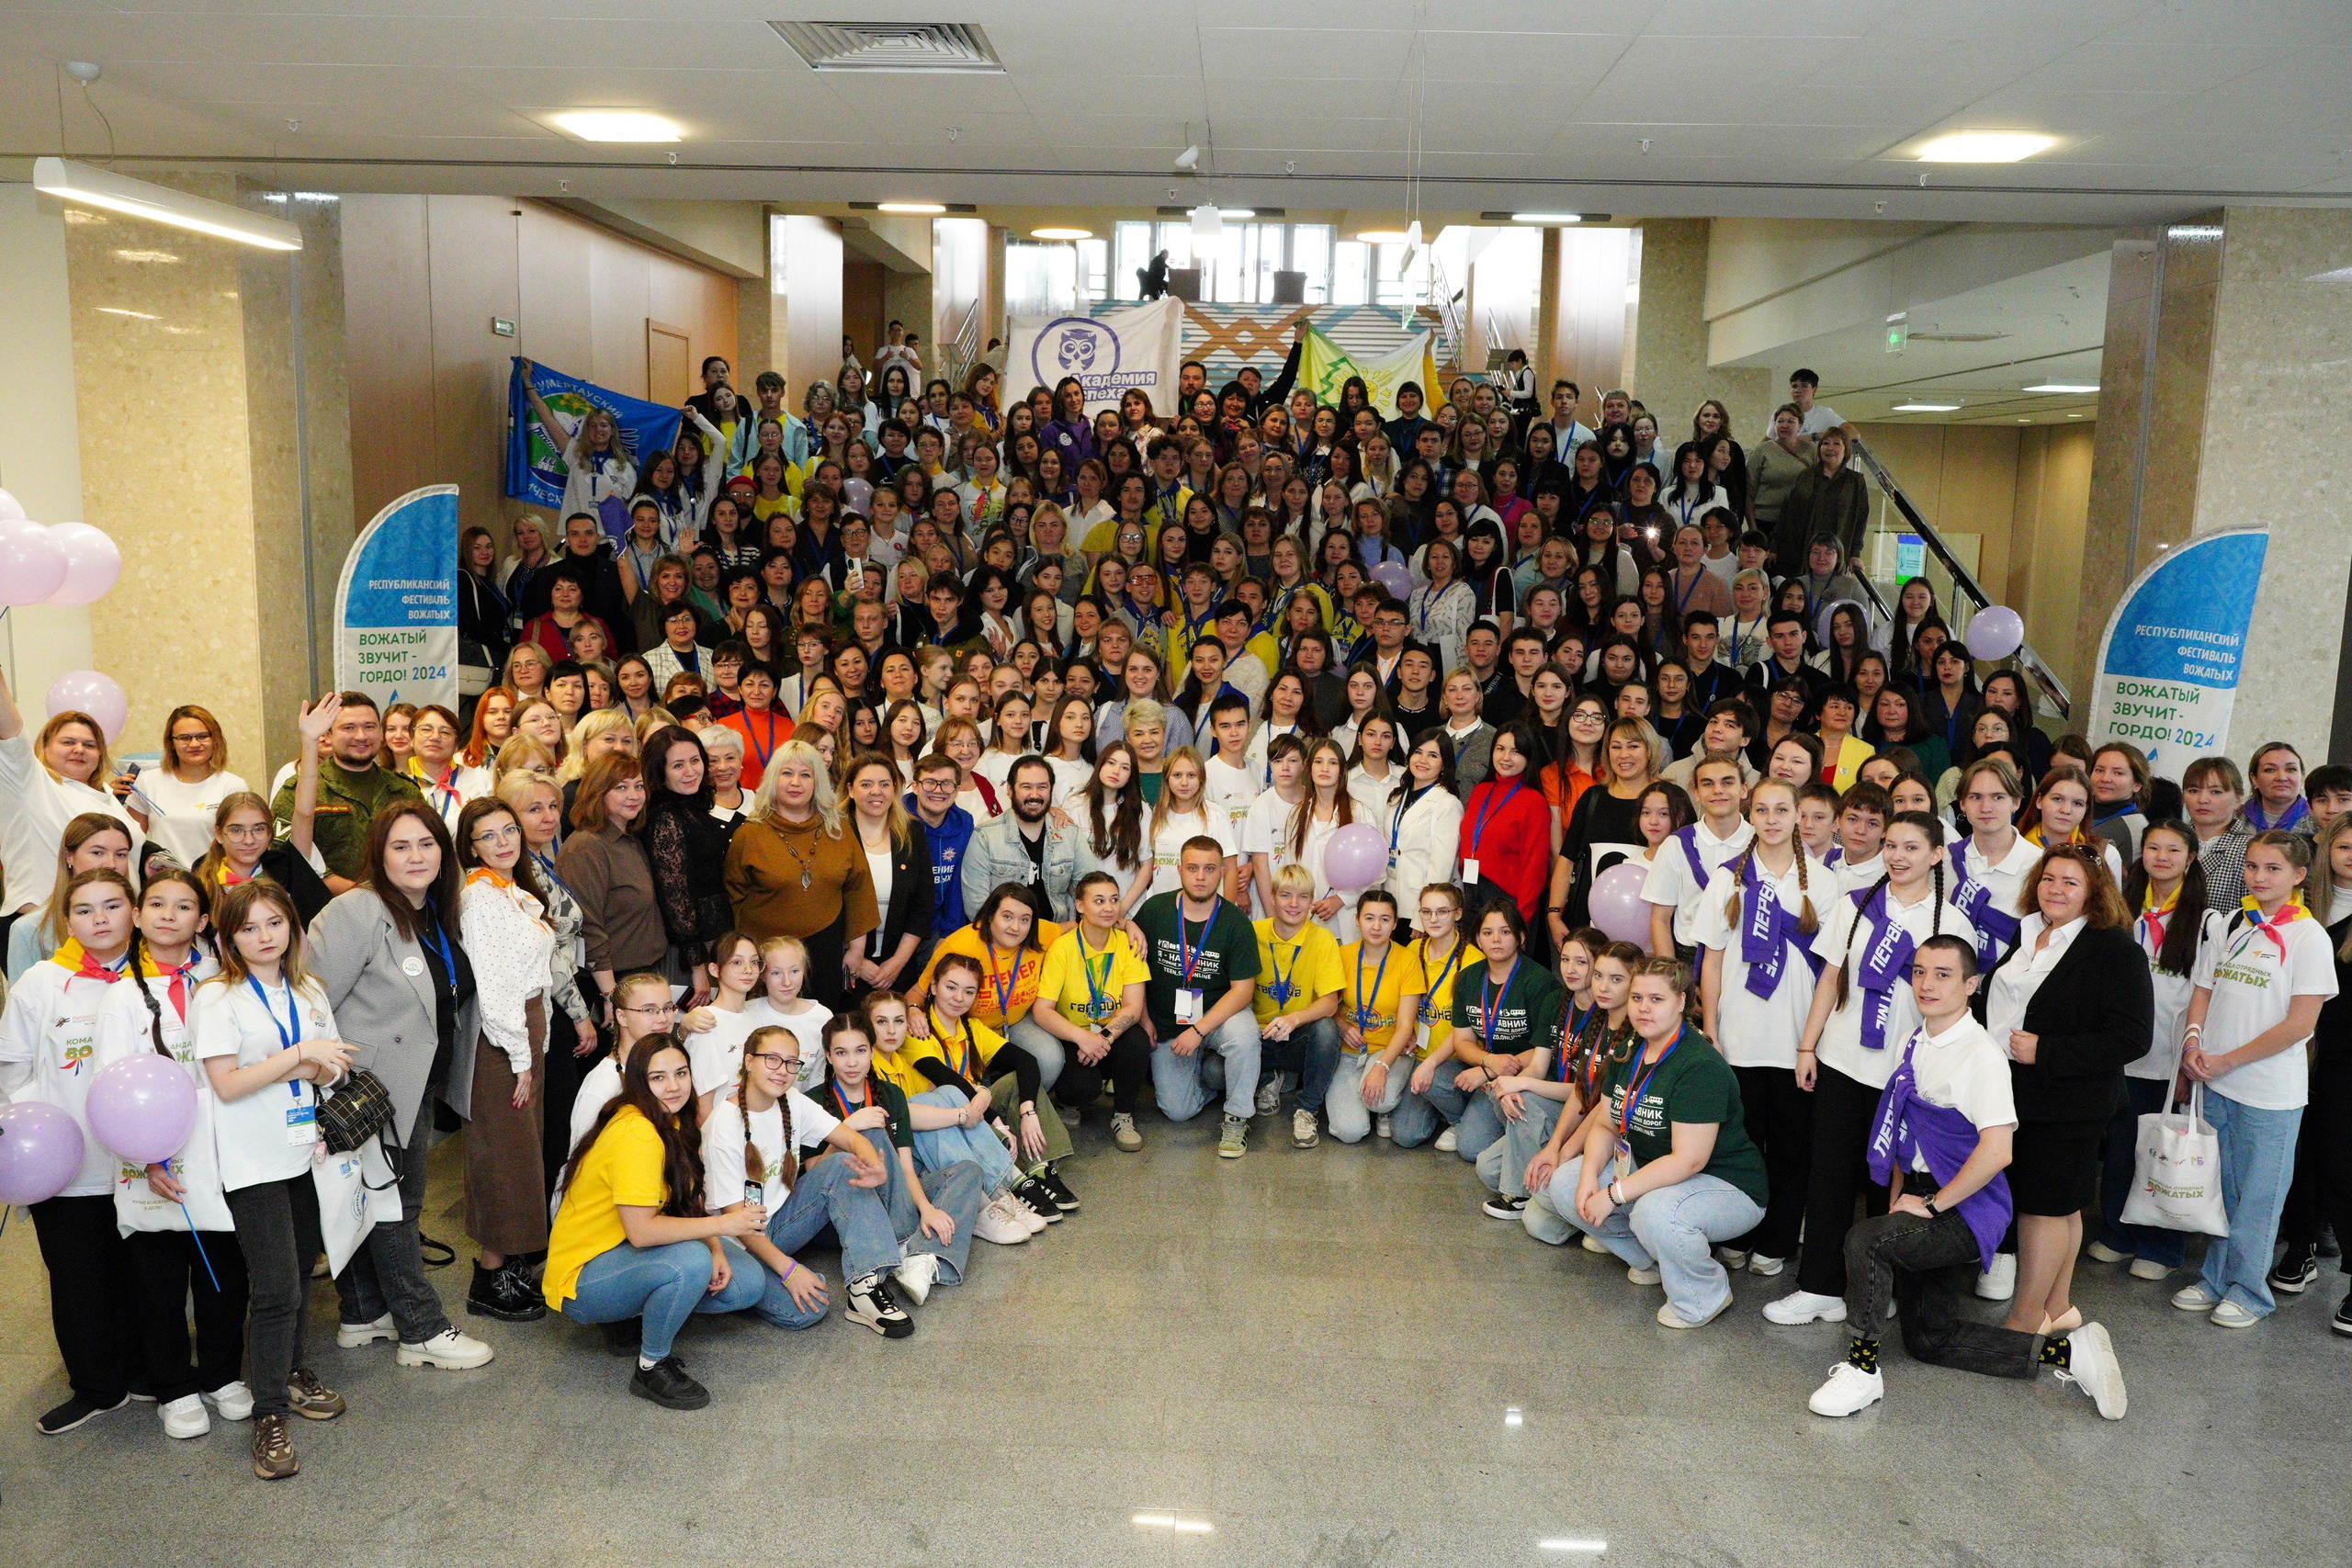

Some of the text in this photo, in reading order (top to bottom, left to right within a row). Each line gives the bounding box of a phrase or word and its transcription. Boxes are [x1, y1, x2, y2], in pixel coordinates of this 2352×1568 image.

[1083, 388, 1125, 401] спеха
[368, 579, 450, 591] РЕСПУБЛИКАНСКИЙ
[401, 594, 450, 605] ФЕСТИВАЛЬ
[408, 609, 450, 620] ВОЖАТЫХ
[359, 629, 426, 646] ВОЖАТЫЙ
[2135, 625, 2240, 647] РЕСПУБЛИКАНСКИЙ
[358, 651, 408, 664] ЗВУЧИТ
[2177, 646, 2236, 664] ФЕСТИВАЛЬ
[359, 666, 447, 683] ГОРДО! 2024
[2183, 663, 2234, 681] ВОЖАТЫХ
[2116, 682, 2200, 705] ВОЖАТЫЙ
[2112, 702, 2177, 721] ЗВУЧИТ
[2109, 721, 2215, 748] ГОРДО! 2024
[932, 864, 956, 874] ЕНИЕ
[933, 874, 953, 884] ВЫХ
[2236, 964, 2271, 977] ОТРЯДНЫХ
[66, 1037, 93, 1045] КОМА
